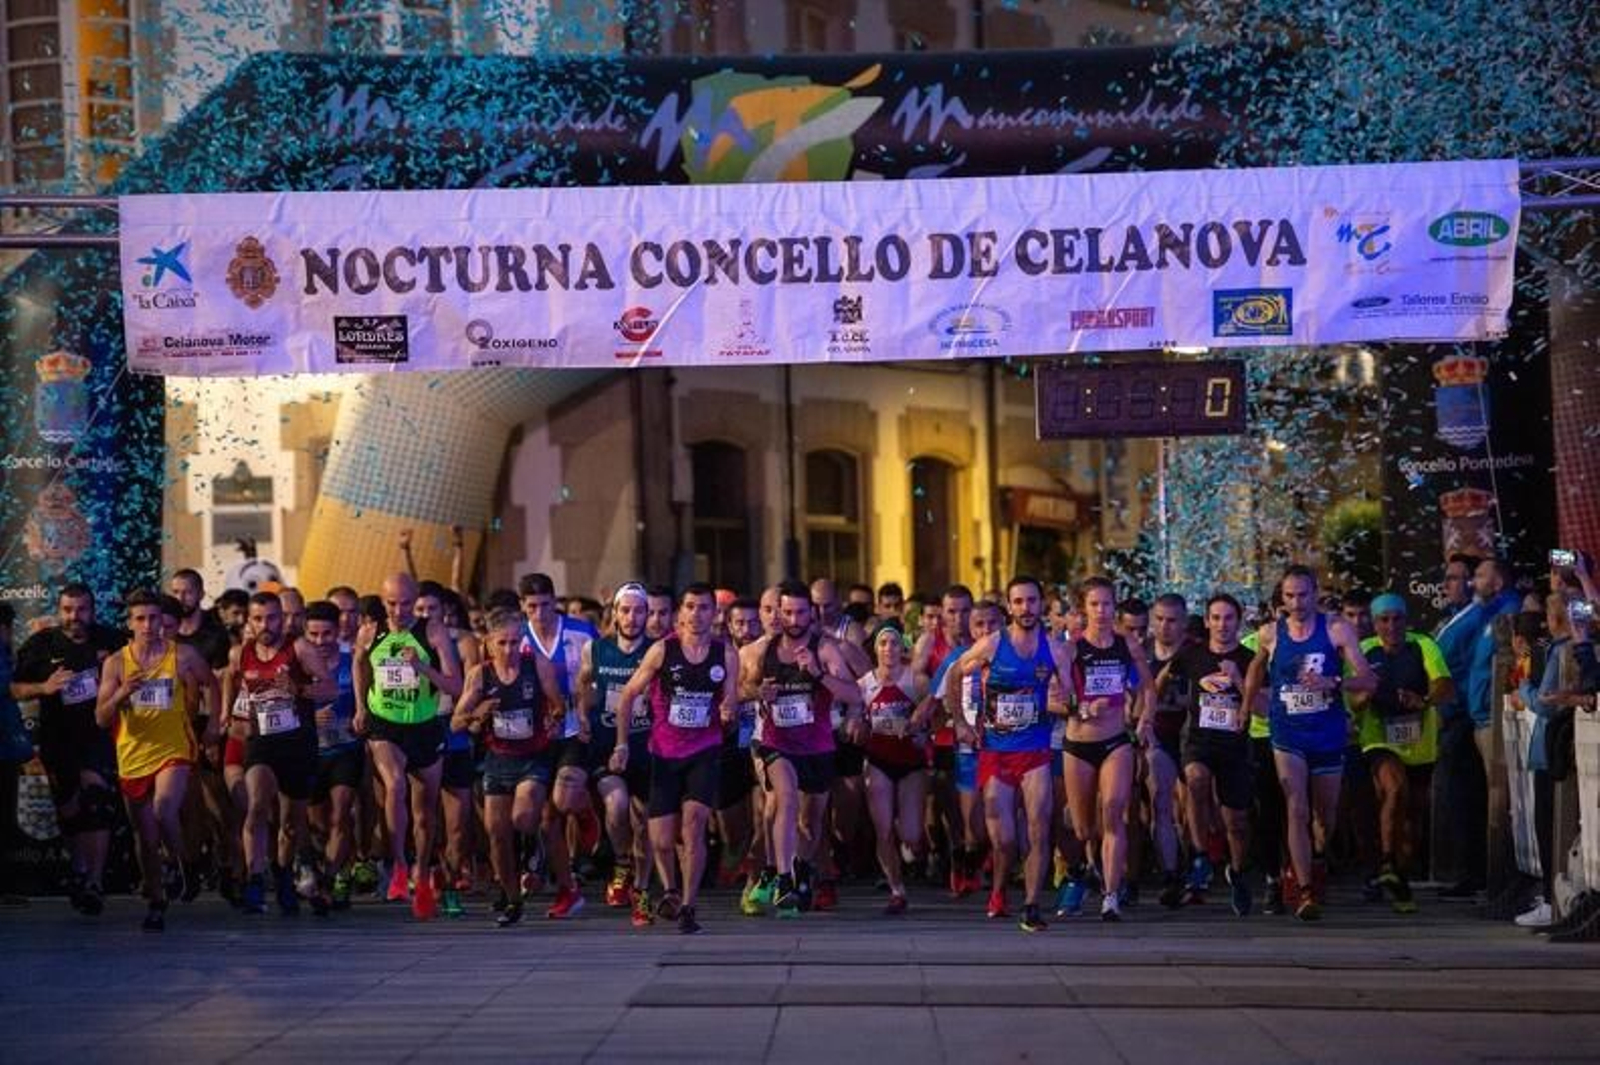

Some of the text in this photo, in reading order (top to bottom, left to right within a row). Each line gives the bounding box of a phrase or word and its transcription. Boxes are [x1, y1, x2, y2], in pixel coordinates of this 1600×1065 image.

[892, 82, 1203, 143] Mancomunidade
[300, 242, 614, 295] NOCTURNA
[630, 233, 911, 289] CONCELLO
[927, 229, 999, 279] DE
[1015, 219, 1306, 276] CELANOVA
[1437, 217, 1502, 240] ABRIL
